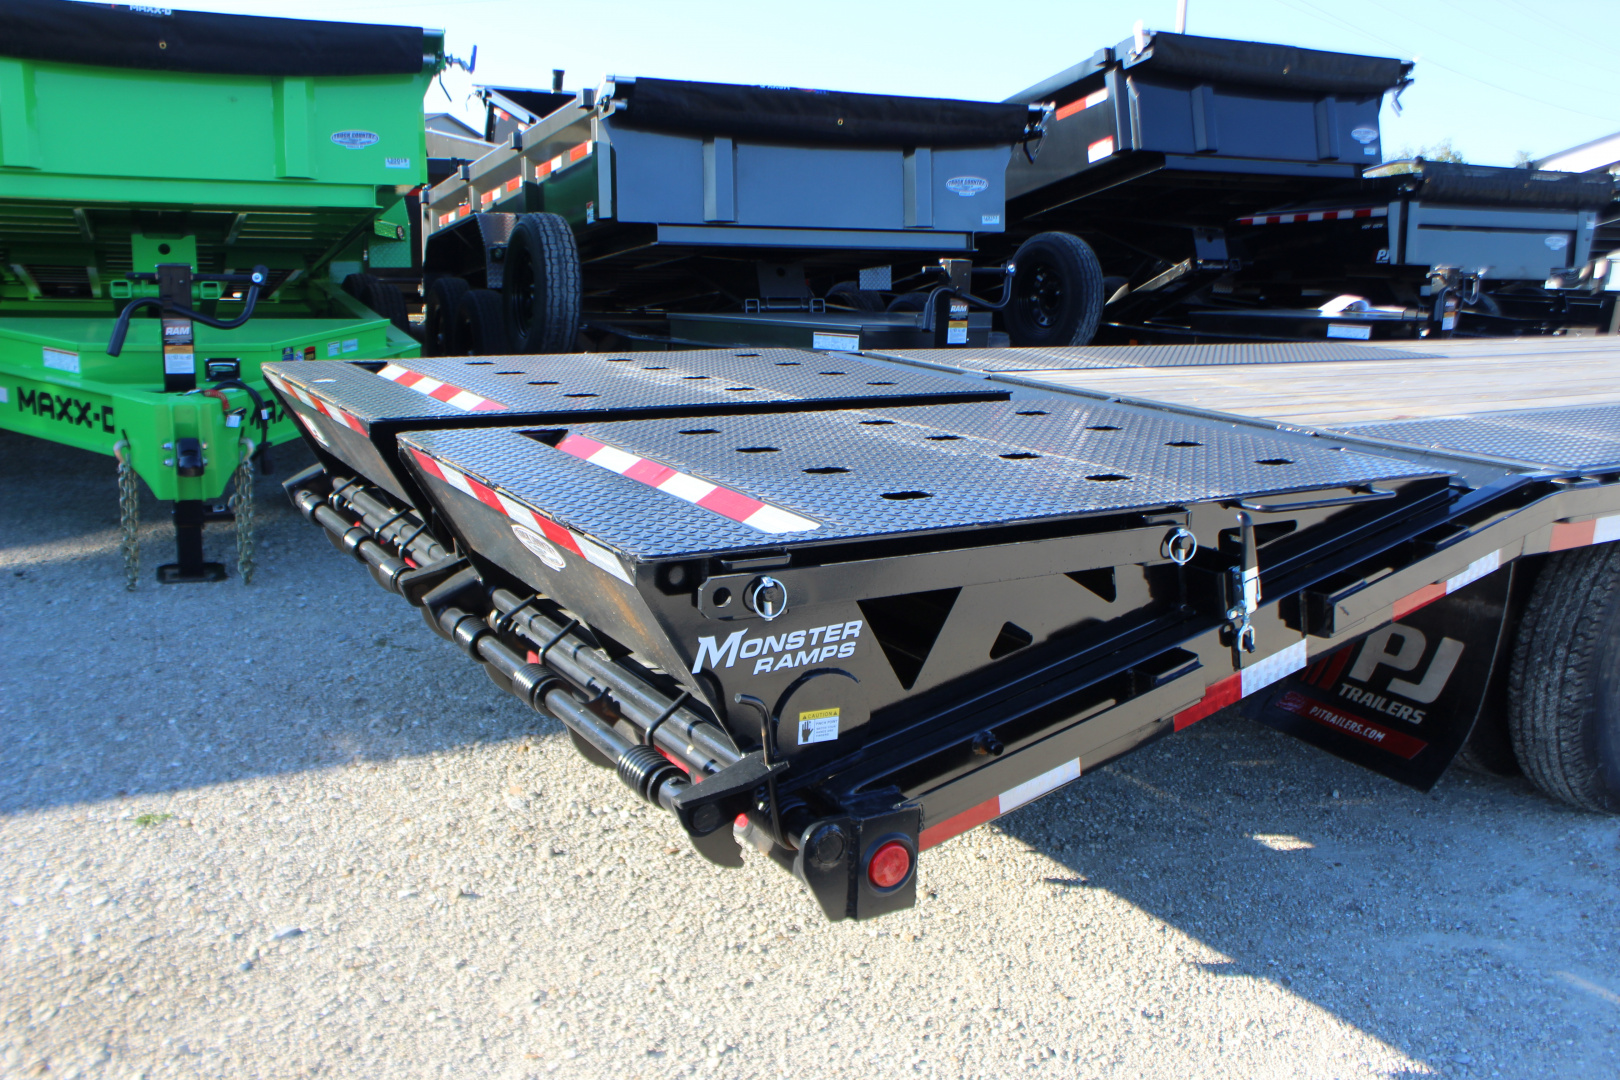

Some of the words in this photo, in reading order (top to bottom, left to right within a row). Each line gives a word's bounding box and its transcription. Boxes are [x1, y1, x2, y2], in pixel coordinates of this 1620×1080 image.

[950, 304, 968, 312] RAM
[165, 326, 190, 336] RAM
[691, 620, 863, 675] MONSTER
[752, 641, 857, 675] RAMPS
[1348, 622, 1465, 704] PJ
[807, 711, 833, 719] CAUTION
[1338, 683, 1426, 725] TRAILERS
[1309, 706, 1387, 743] PJTRAILERS.COM
